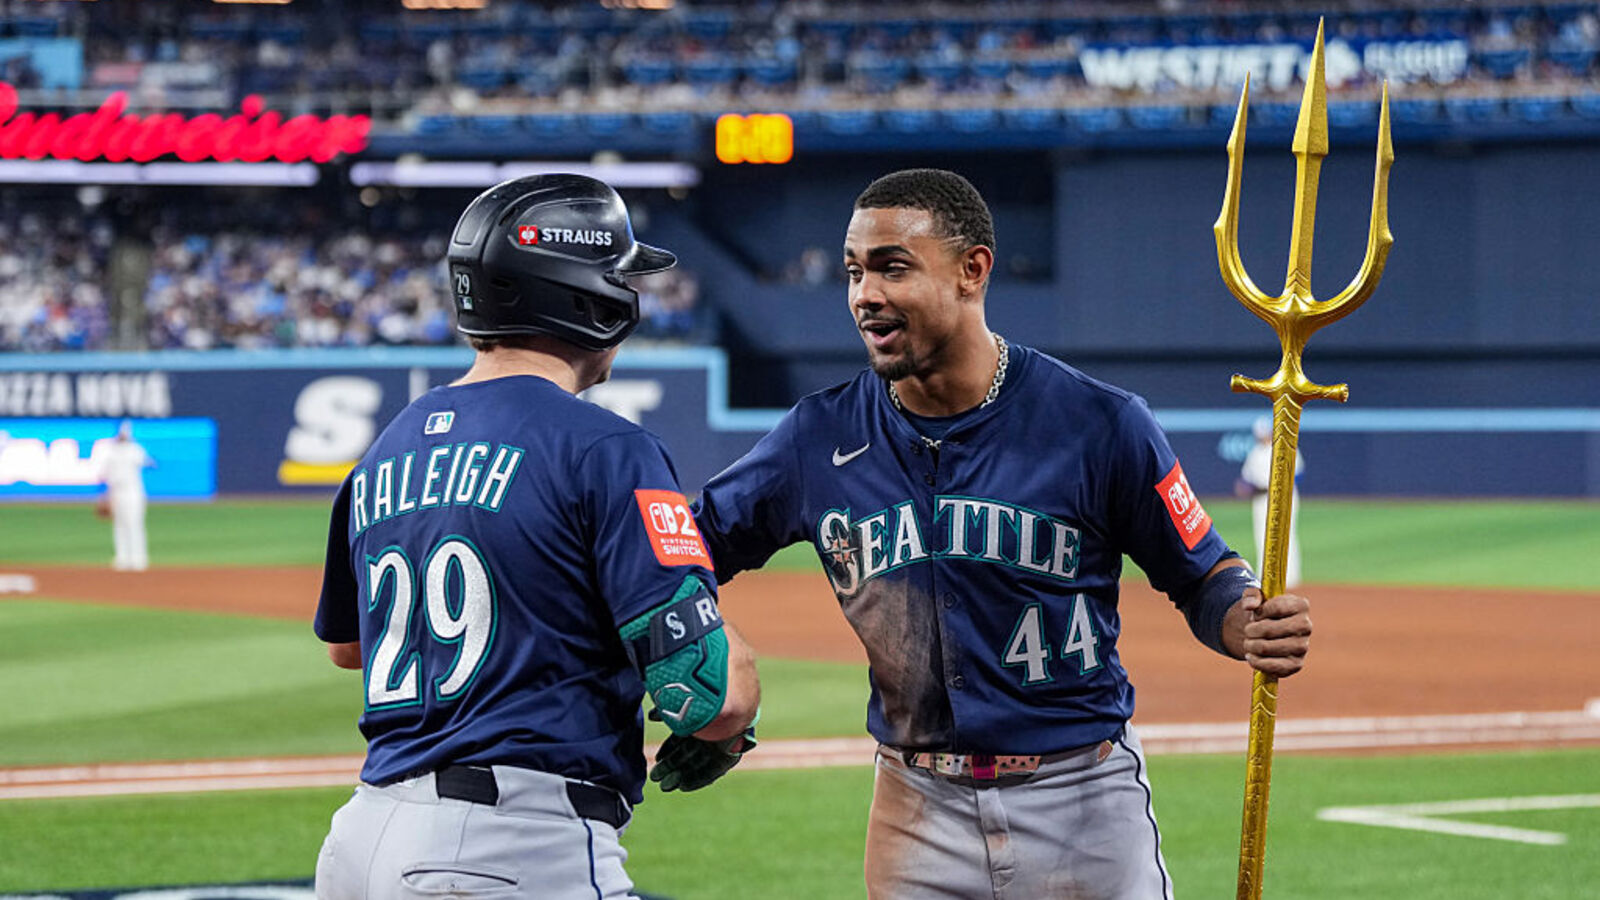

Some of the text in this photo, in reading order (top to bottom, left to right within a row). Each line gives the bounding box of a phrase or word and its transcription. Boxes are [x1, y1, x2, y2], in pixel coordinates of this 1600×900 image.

[454, 273, 470, 295] 29
[541, 227, 612, 247] STRAUSS
[352, 441, 526, 538] RALEIGH
[817, 495, 1081, 598] SEATTLE
[365, 533, 498, 712] 29
[1001, 590, 1105, 687] 44
